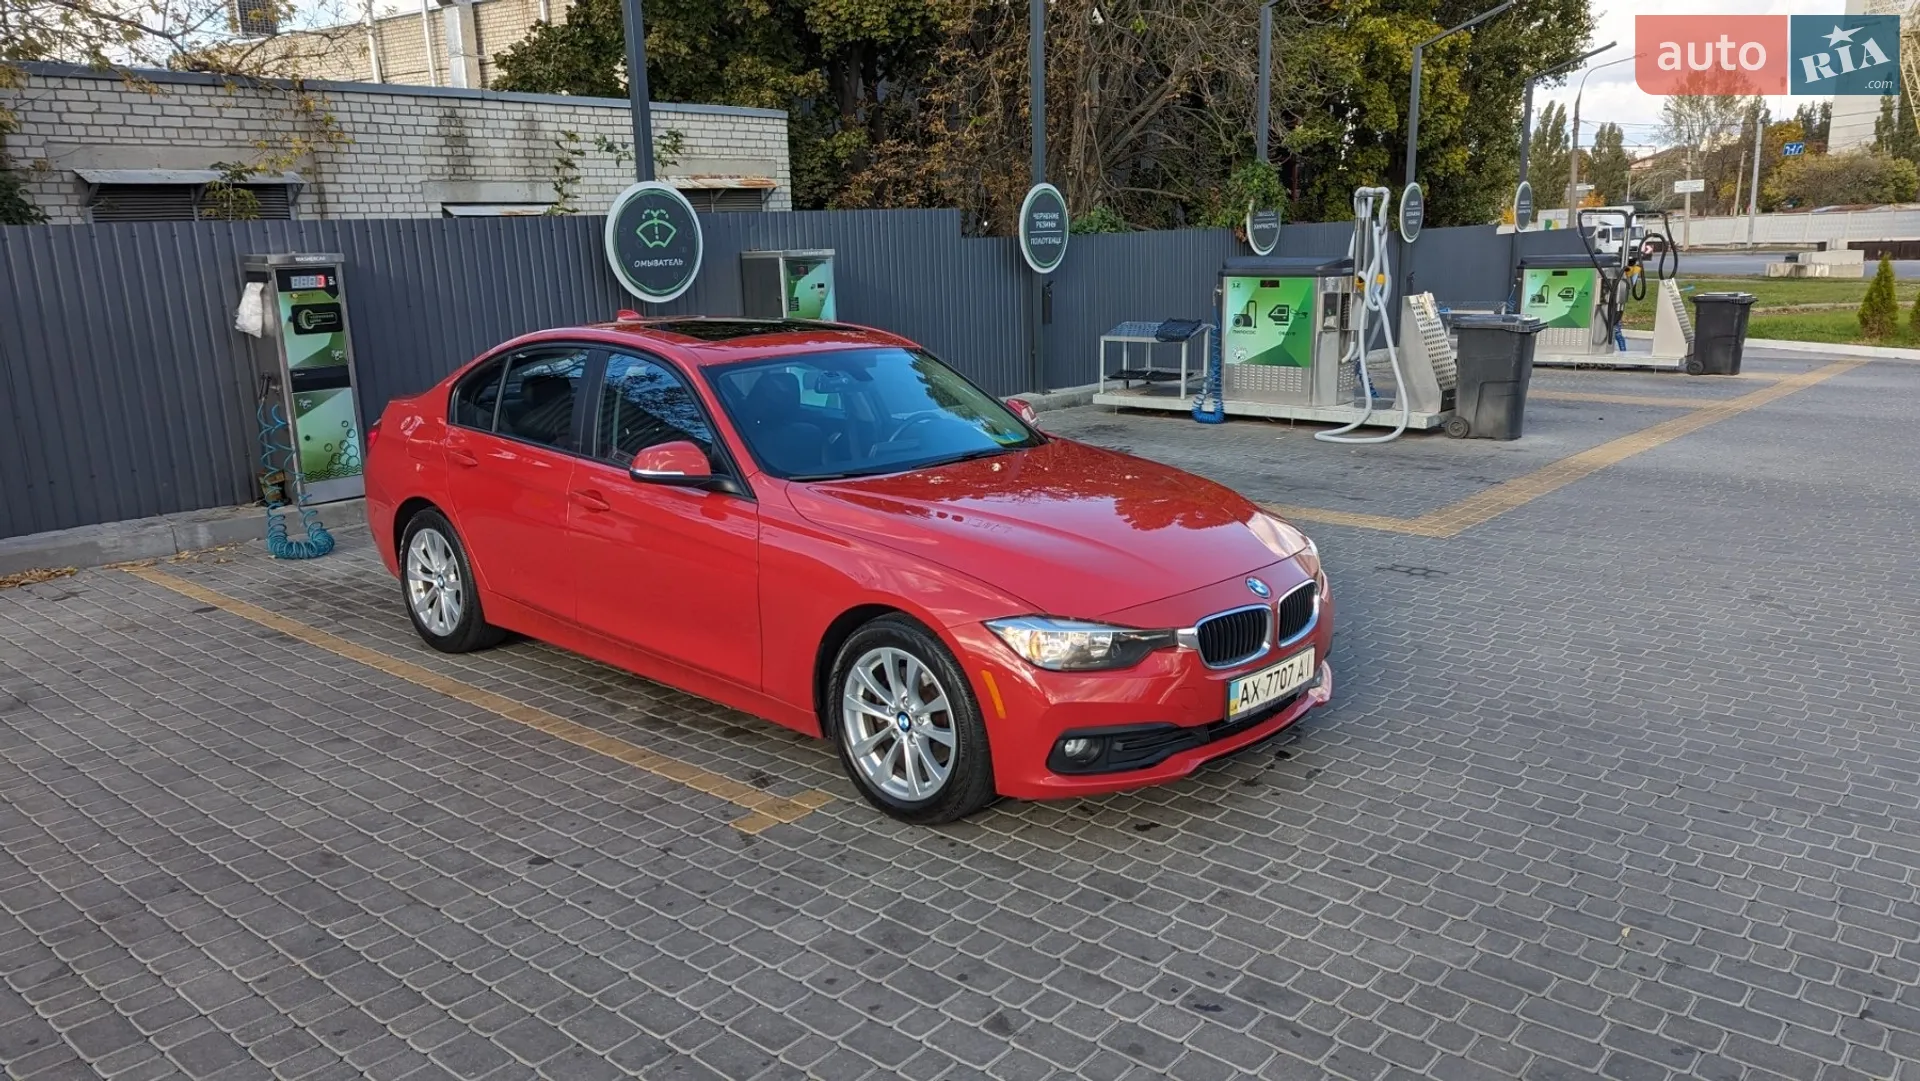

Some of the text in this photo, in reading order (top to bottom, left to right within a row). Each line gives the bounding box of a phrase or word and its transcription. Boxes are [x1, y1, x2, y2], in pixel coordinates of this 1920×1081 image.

[634, 258, 684, 268] ОМЫВАТЕЛЬ
[1240, 677, 1261, 708] AX
[1266, 662, 1294, 697] 7707
[1297, 654, 1310, 682] AI
